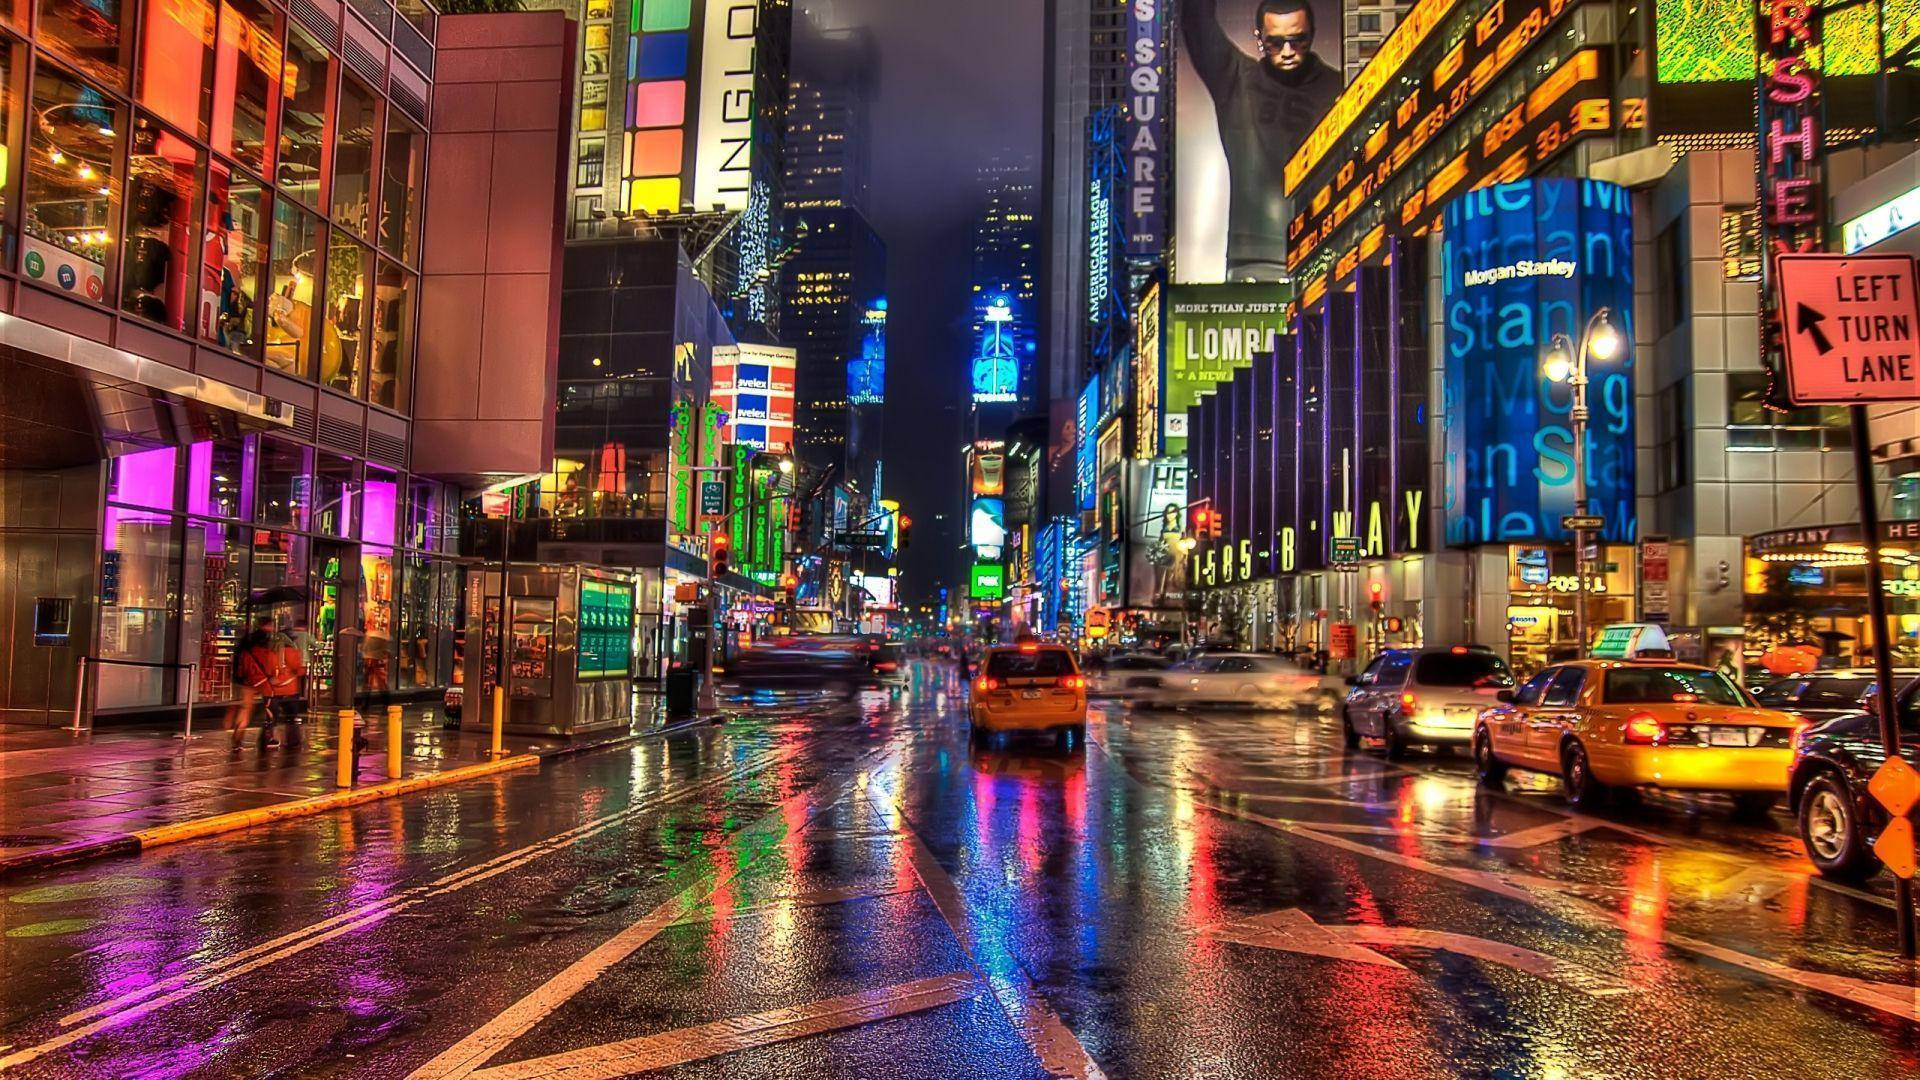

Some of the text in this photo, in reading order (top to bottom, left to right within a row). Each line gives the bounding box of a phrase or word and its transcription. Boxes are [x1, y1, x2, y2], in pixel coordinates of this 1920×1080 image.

[1131, 37, 1160, 213] SQUARE
[1089, 180, 1101, 323] AMERICAN EAGLE
[1099, 199, 1109, 300] OUTFITTERS
[1464, 258, 1576, 287] Morgan Stanley
[1836, 274, 1902, 302] LEFT
[1175, 304, 1208, 313] MORE
[1211, 304, 1243, 313] THAN
[1245, 303, 1277, 313] JUST
[1838, 315, 1910, 342] TURN
[1843, 354, 1914, 382] LANE
[735, 450, 746, 494] OLIVE
[1759, 529, 1830, 548] COMPANY
